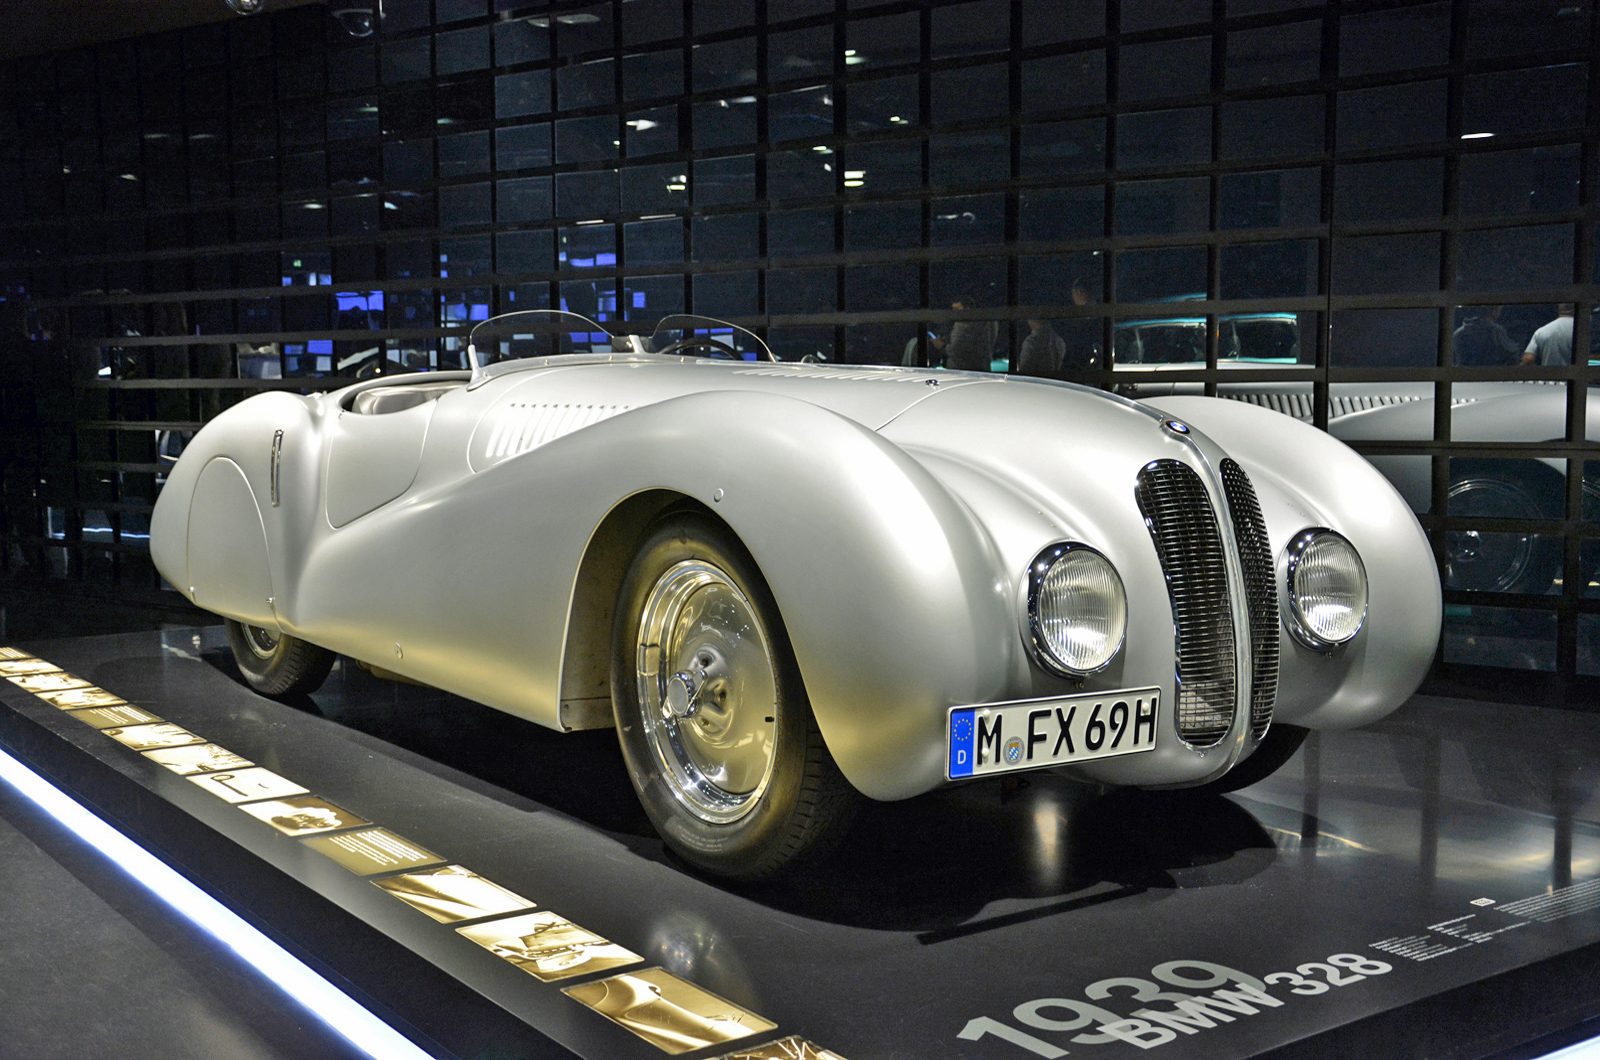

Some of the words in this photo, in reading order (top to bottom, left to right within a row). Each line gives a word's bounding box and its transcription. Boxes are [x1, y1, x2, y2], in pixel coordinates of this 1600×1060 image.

[957, 750, 967, 765] D
[976, 713, 1003, 766] M
[1026, 706, 1077, 760] FX
[1085, 697, 1158, 751] 69H
[956, 960, 1267, 1060] 1939
[1096, 982, 1285, 1050] BMW
[1264, 953, 1393, 996] 328
